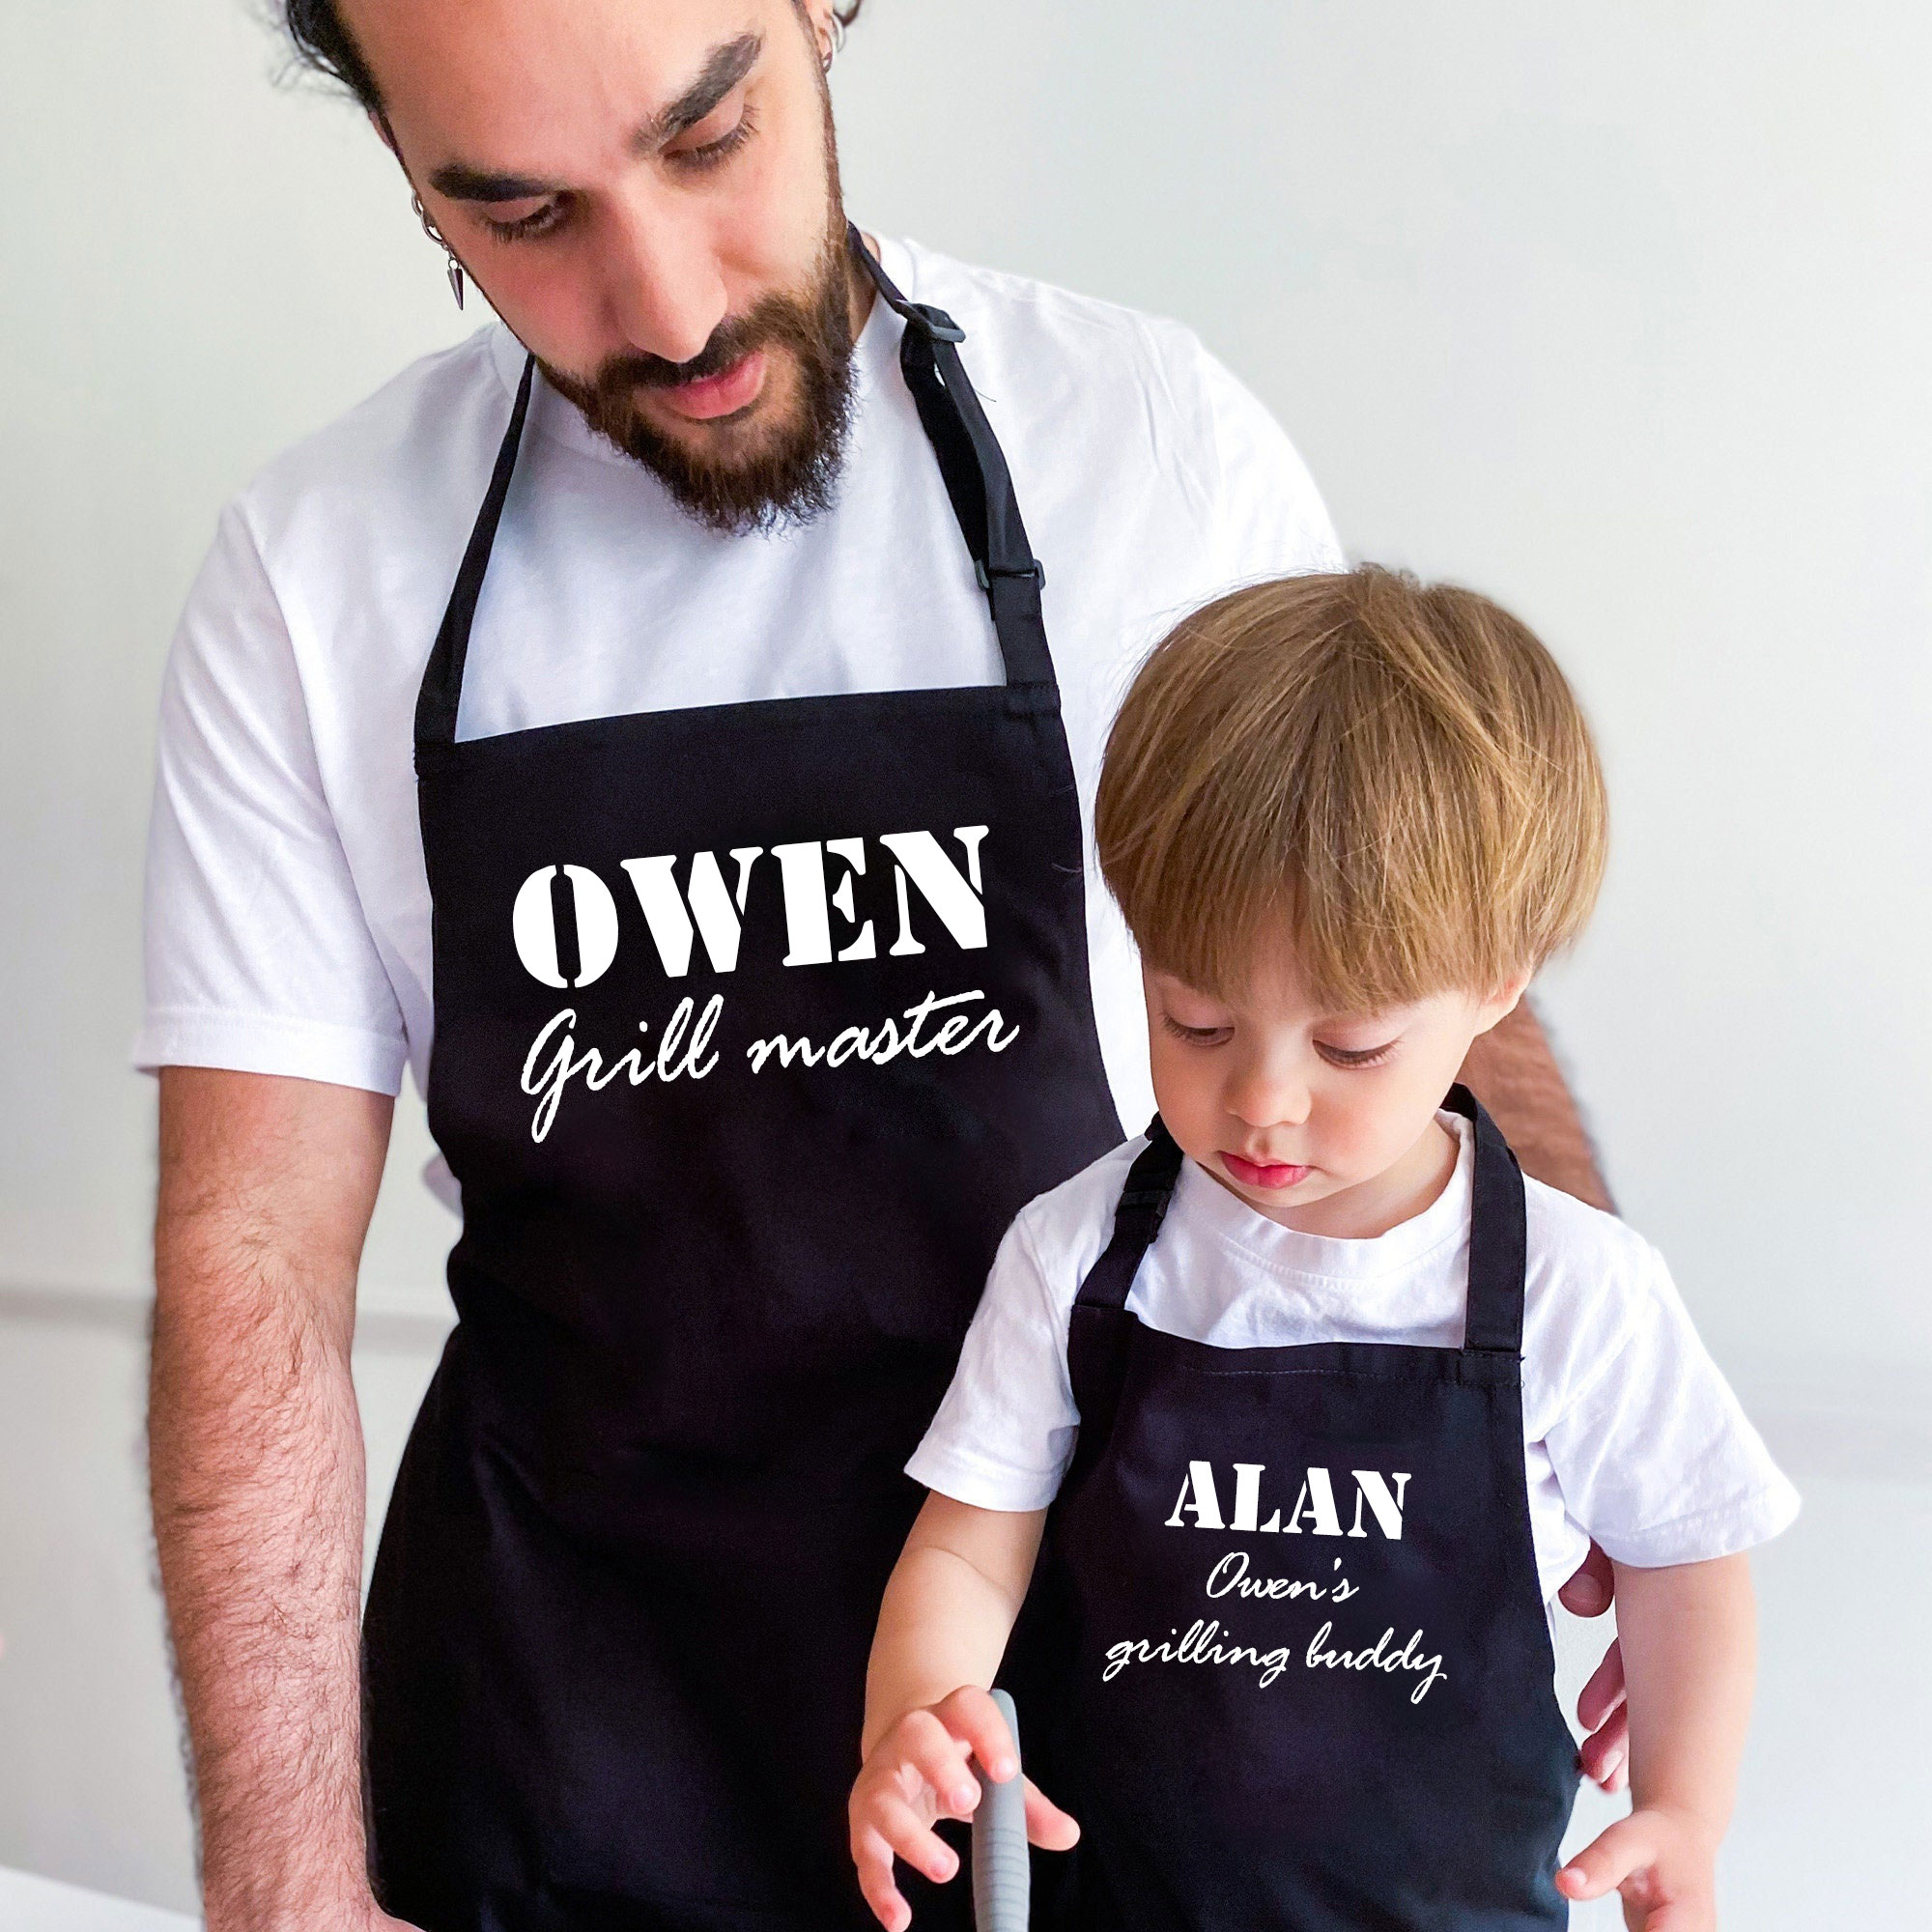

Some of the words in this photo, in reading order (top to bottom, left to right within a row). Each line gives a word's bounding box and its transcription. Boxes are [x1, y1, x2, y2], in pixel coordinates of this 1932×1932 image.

[512, 824, 990, 989] OWEN
[520, 993, 724, 1144] Grill
[746, 989, 1020, 1075] master
[1164, 1460, 1412, 1541] ALAN
[1206, 1551, 1360, 1604] Owen's
[1101, 1618, 1291, 1690] grilling
[1305, 1620, 1448, 1705] buddy
